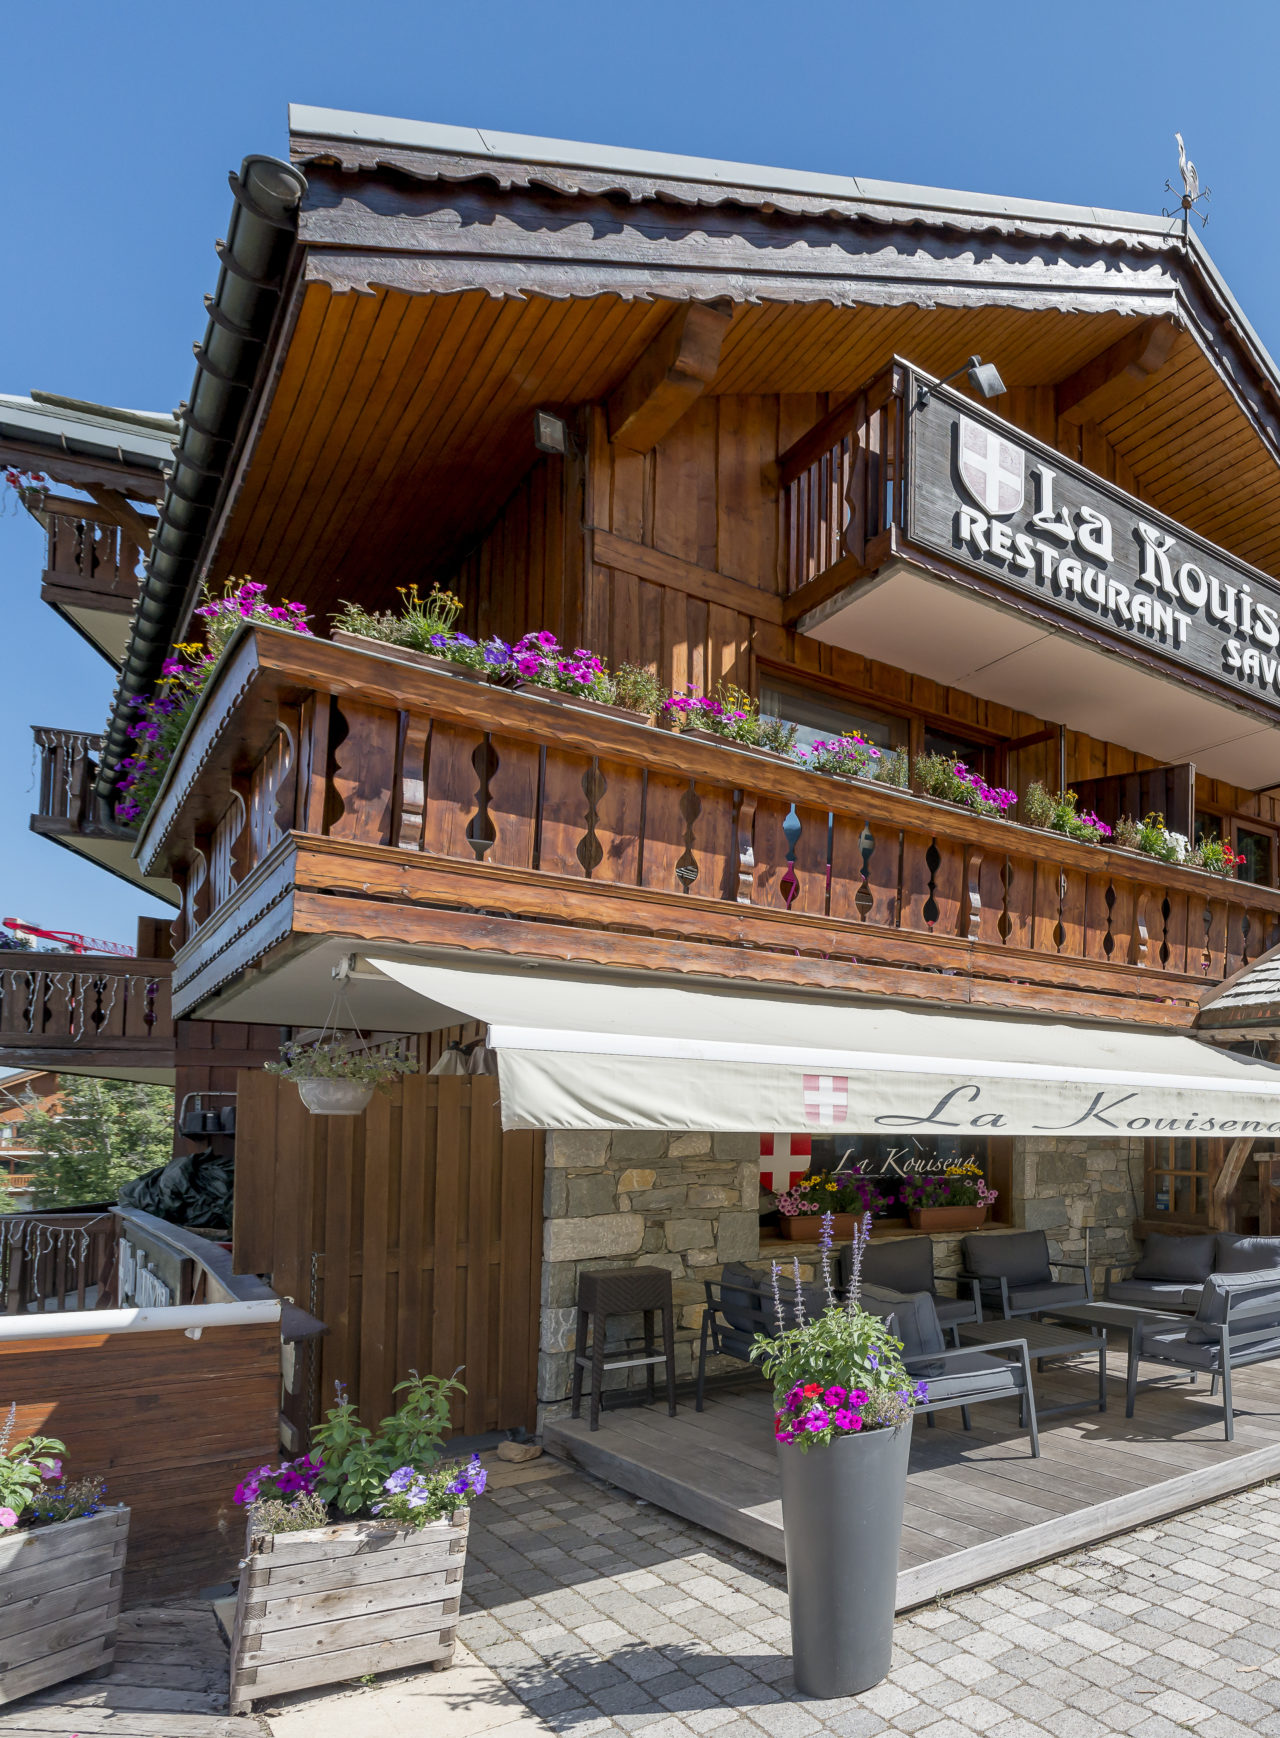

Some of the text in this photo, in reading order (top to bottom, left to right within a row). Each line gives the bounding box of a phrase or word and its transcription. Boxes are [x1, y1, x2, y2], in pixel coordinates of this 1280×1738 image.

[1031, 463, 1114, 563] La
[959, 504, 1193, 643] RESTAURANT
[874, 1084, 1008, 1128] La
[830, 1148, 874, 1174] La
